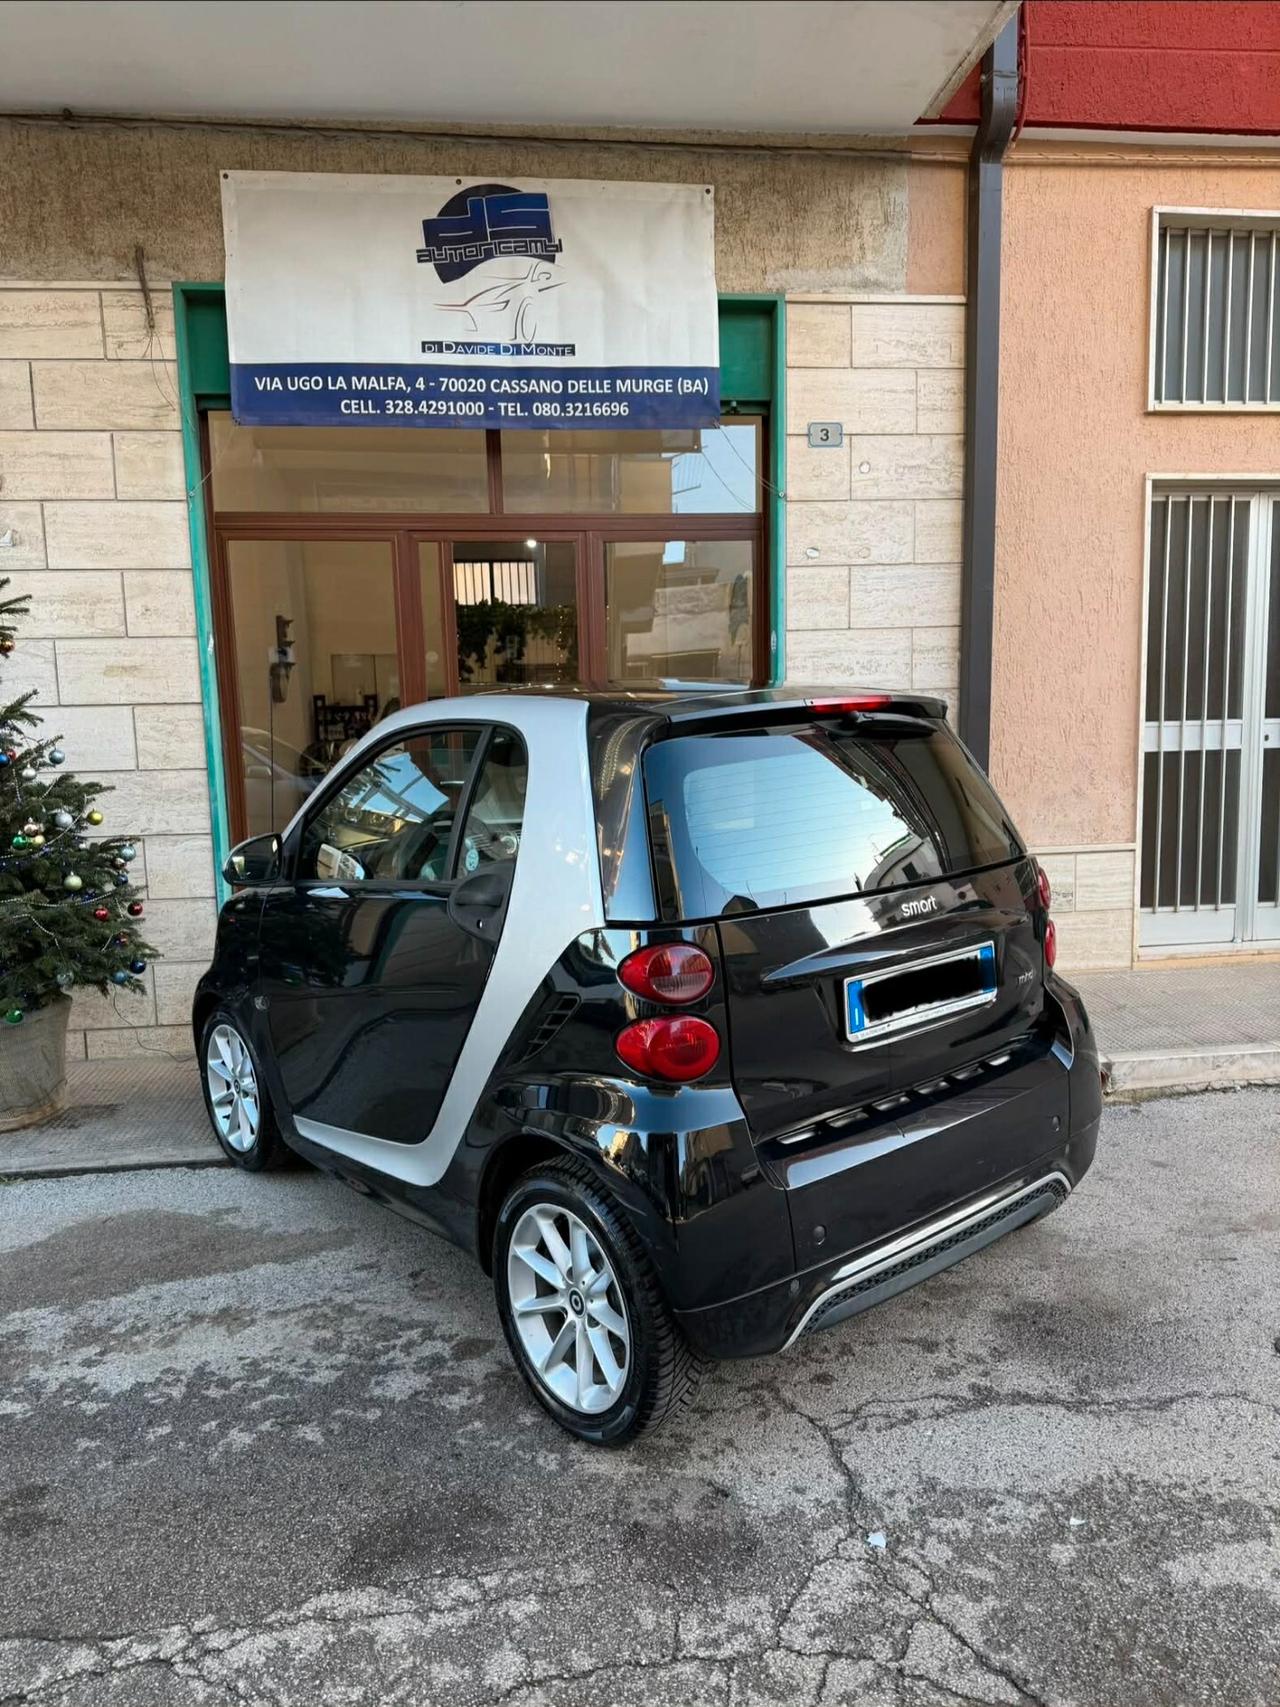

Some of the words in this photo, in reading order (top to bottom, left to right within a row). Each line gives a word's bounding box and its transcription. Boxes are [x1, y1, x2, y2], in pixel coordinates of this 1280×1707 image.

[255, 376, 283, 391] VIA
[287, 376, 323, 391] UGO
[327, 376, 347, 391] LA
[352, 376, 411, 393] MALFA,
[415, 377, 425, 391] 4
[439, 377, 486, 393] 70020
[490, 378, 563, 394] CASSANO
[568, 379, 611, 394] DELLE
[616, 379, 673, 393] MURGE
[677, 377, 708, 395] (BA)
[340, 400, 380, 414] CELL.
[385, 400, 484, 416] 328.4291000
[498, 402, 528, 416] TEL.
[532, 402, 629, 417] 080.3216696
[820, 428, 829, 442] 3
[901, 895, 938, 917] smart
